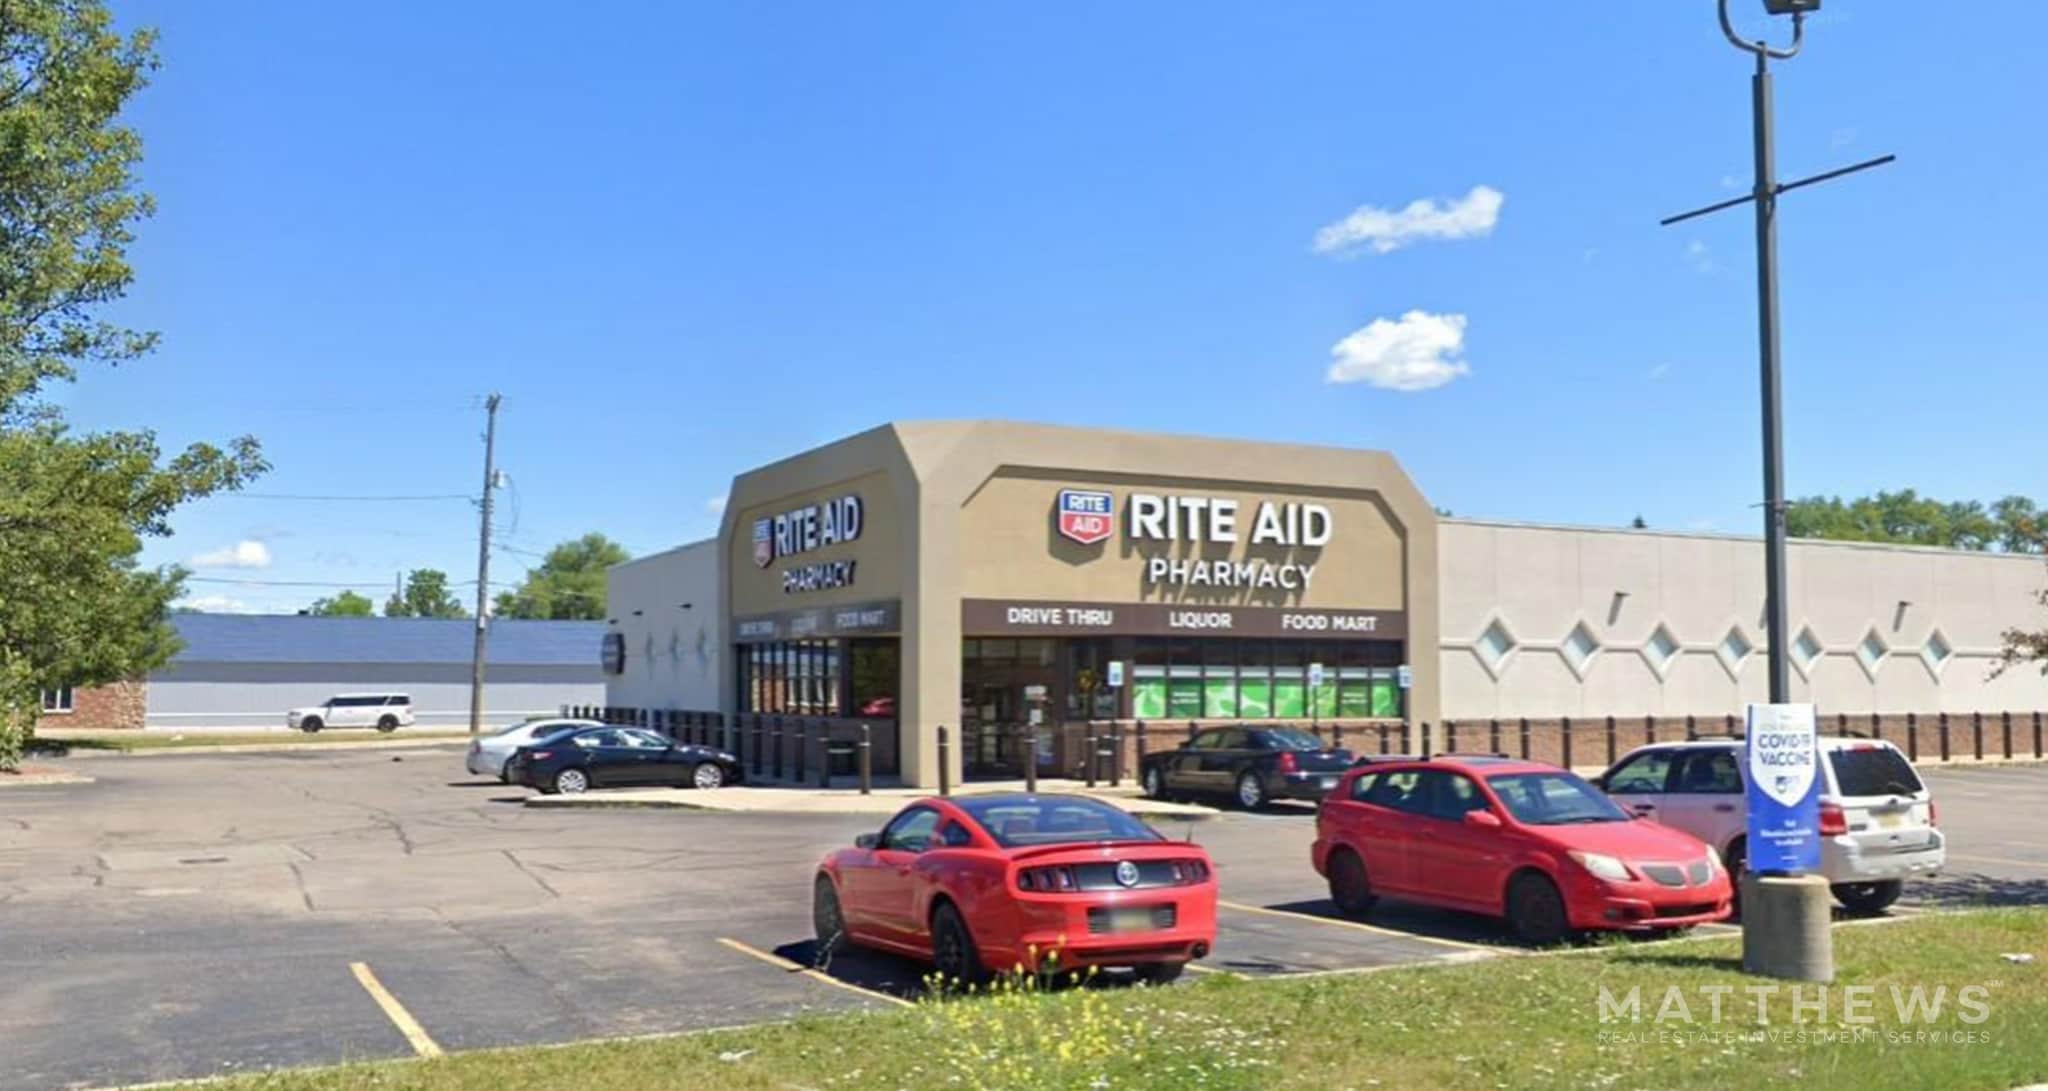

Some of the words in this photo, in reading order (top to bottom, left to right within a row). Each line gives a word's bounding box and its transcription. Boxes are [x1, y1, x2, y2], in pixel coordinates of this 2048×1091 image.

[1068, 495, 1105, 512] RITE
[775, 506, 817, 557] RITE
[821, 496, 859, 545] AID
[1070, 516, 1102, 533] AID
[1130, 493, 1239, 542] RITE
[1252, 501, 1333, 546] AID
[1149, 558, 1317, 589] PHARMACY
[1007, 607, 1062, 624] DRIVE
[1067, 608, 1113, 626] THRU
[1169, 611, 1232, 630] LIQUOR
[1281, 615, 1328, 631] FOOD
[1332, 616, 1378, 632] MART
